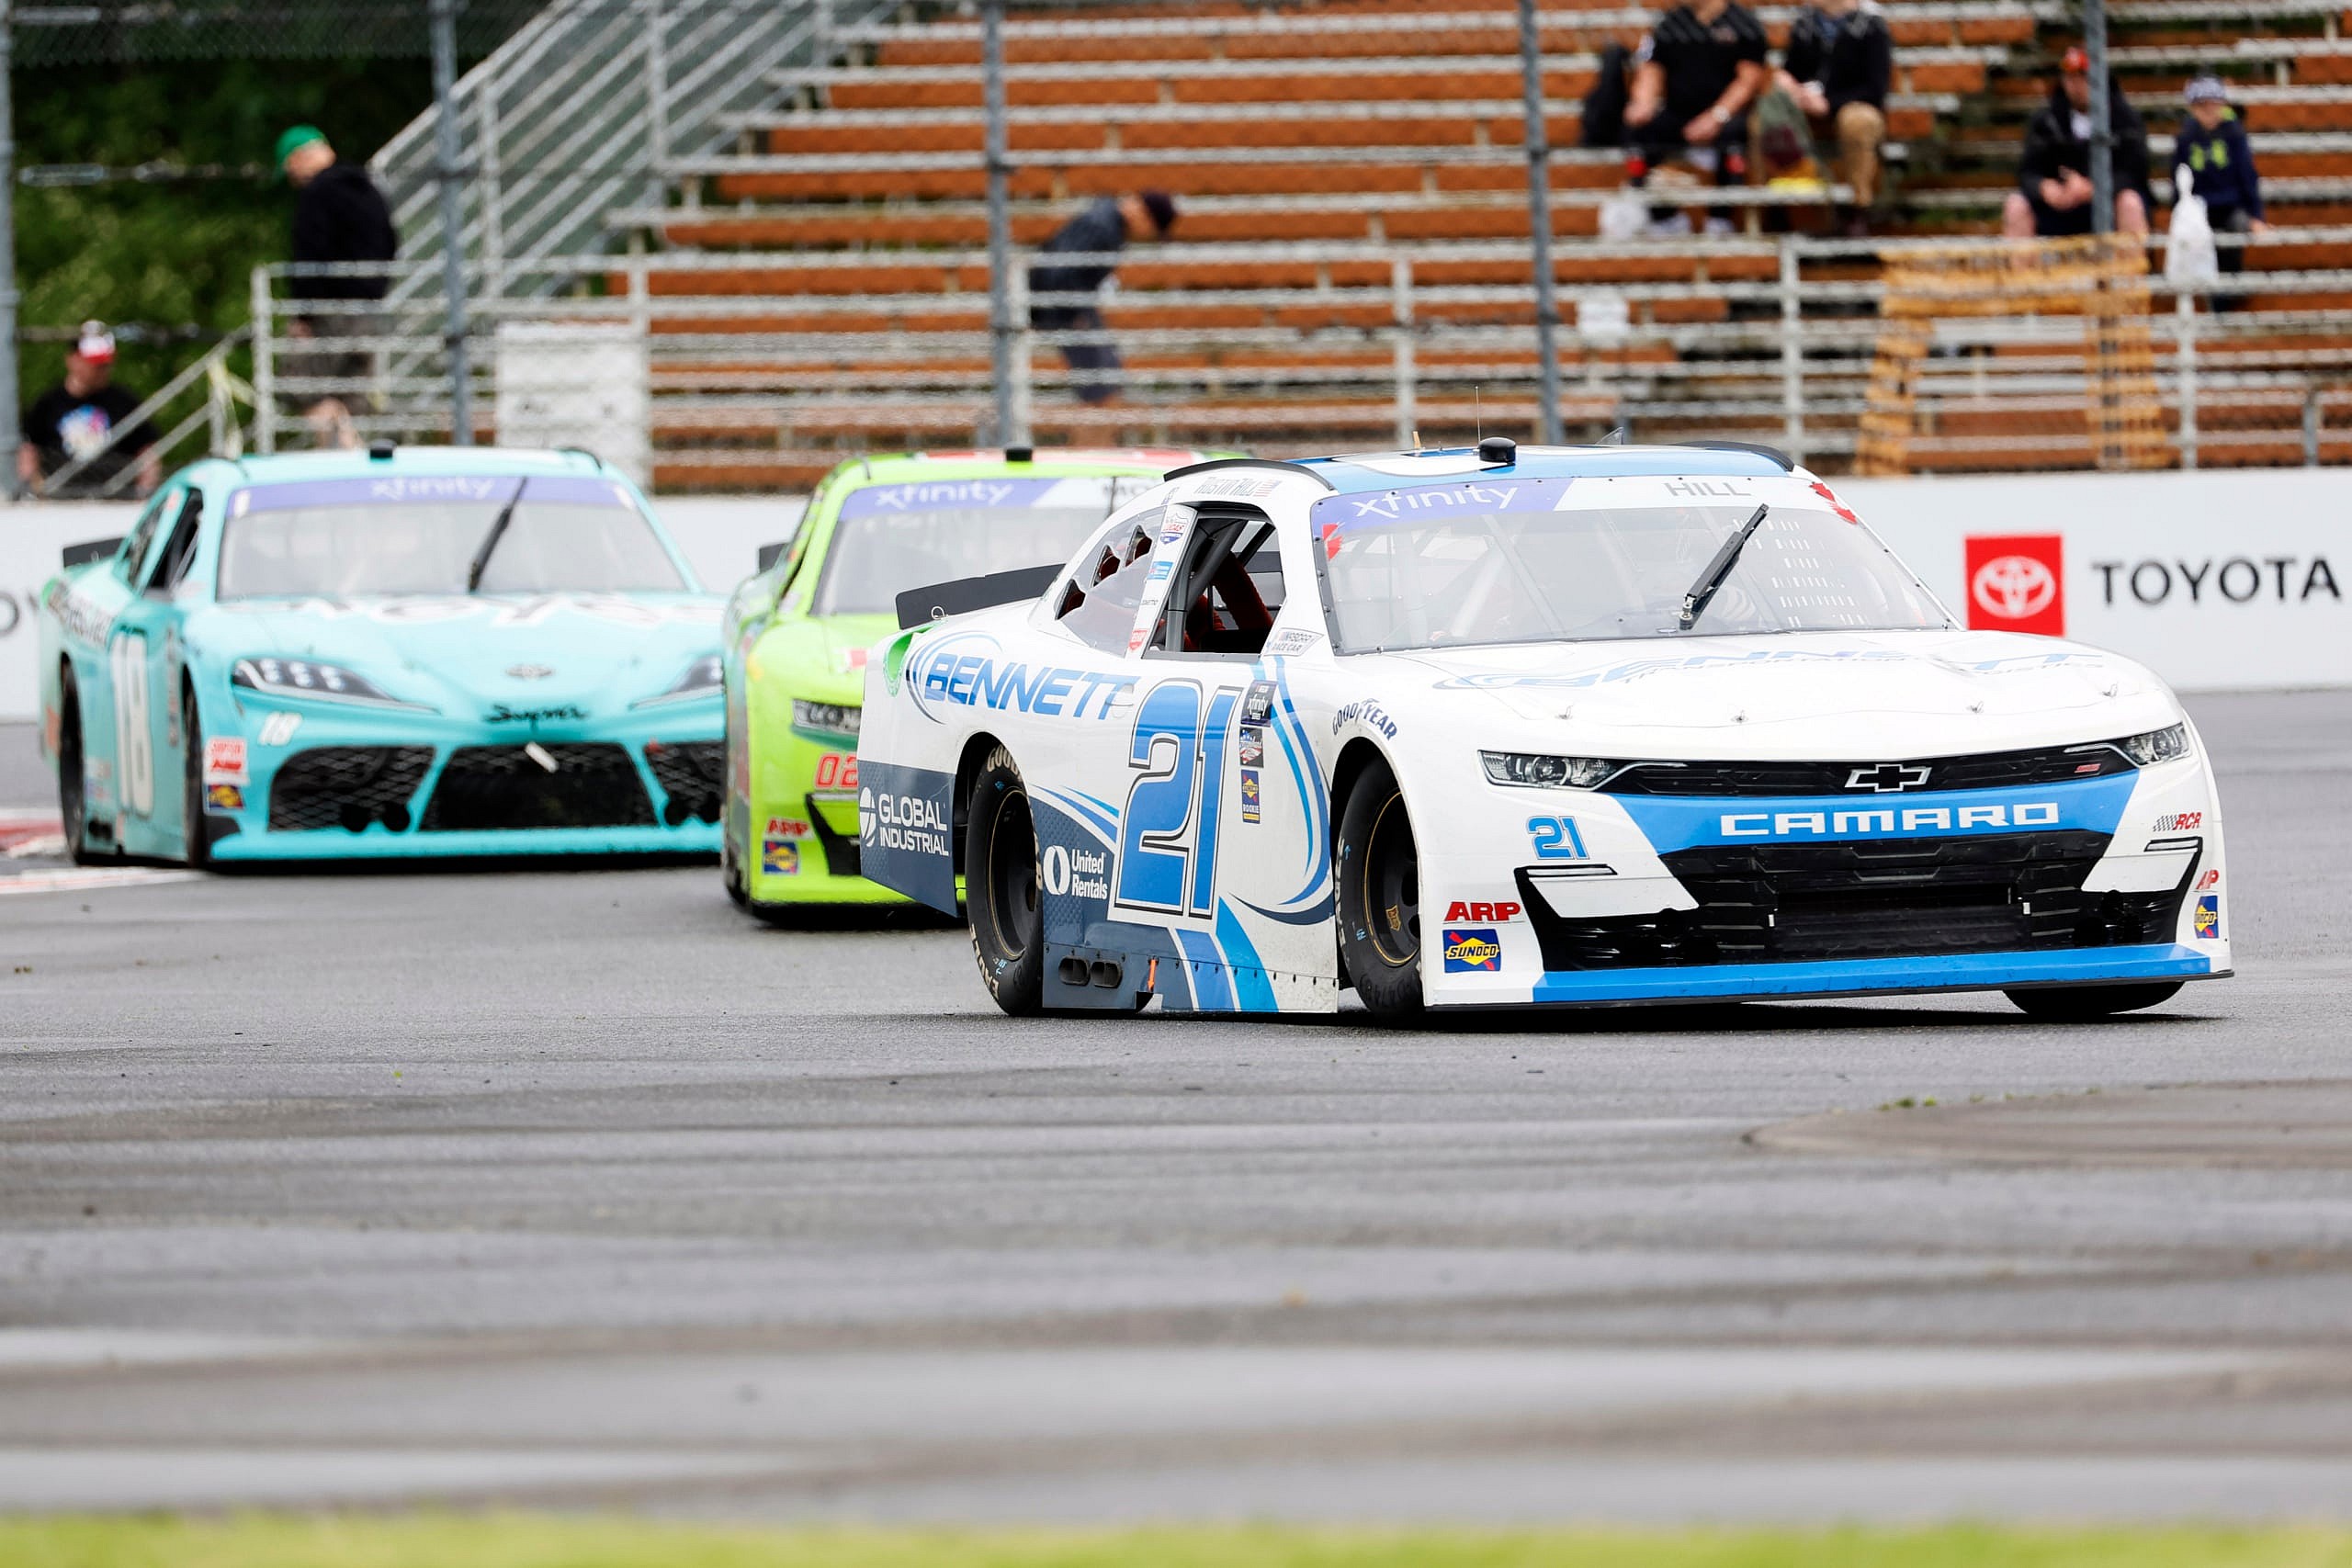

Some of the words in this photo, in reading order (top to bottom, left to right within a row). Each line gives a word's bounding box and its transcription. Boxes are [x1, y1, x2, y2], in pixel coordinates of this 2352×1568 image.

[371, 476, 494, 500] xfinity
[875, 479, 1014, 510] xfinity
[1352, 485, 1518, 518] xfinity
[1664, 481, 1752, 497] HILL
[2091, 557, 2342, 606] TOYOTA
[924, 653, 1141, 720] BENNETT
[1247, 693, 1270, 717] xfinity
[1333, 698, 1397, 740] GOODYEAR
[110, 634, 154, 819] 18
[259, 711, 302, 745] 18
[815, 752, 859, 789] 02
[878, 793, 948, 831] GLOBAL
[1113, 677, 1244, 920] 21
[1721, 802, 2059, 837] CAMARO
[879, 827, 950, 856] INDUSTRIAL
[1525, 815, 1590, 861] 21
[1071, 849, 1103, 874] United
[1071, 874, 1108, 900] Rentals
[1443, 900, 1521, 922] ARP
[1448, 945, 1498, 957] SUNOCO
